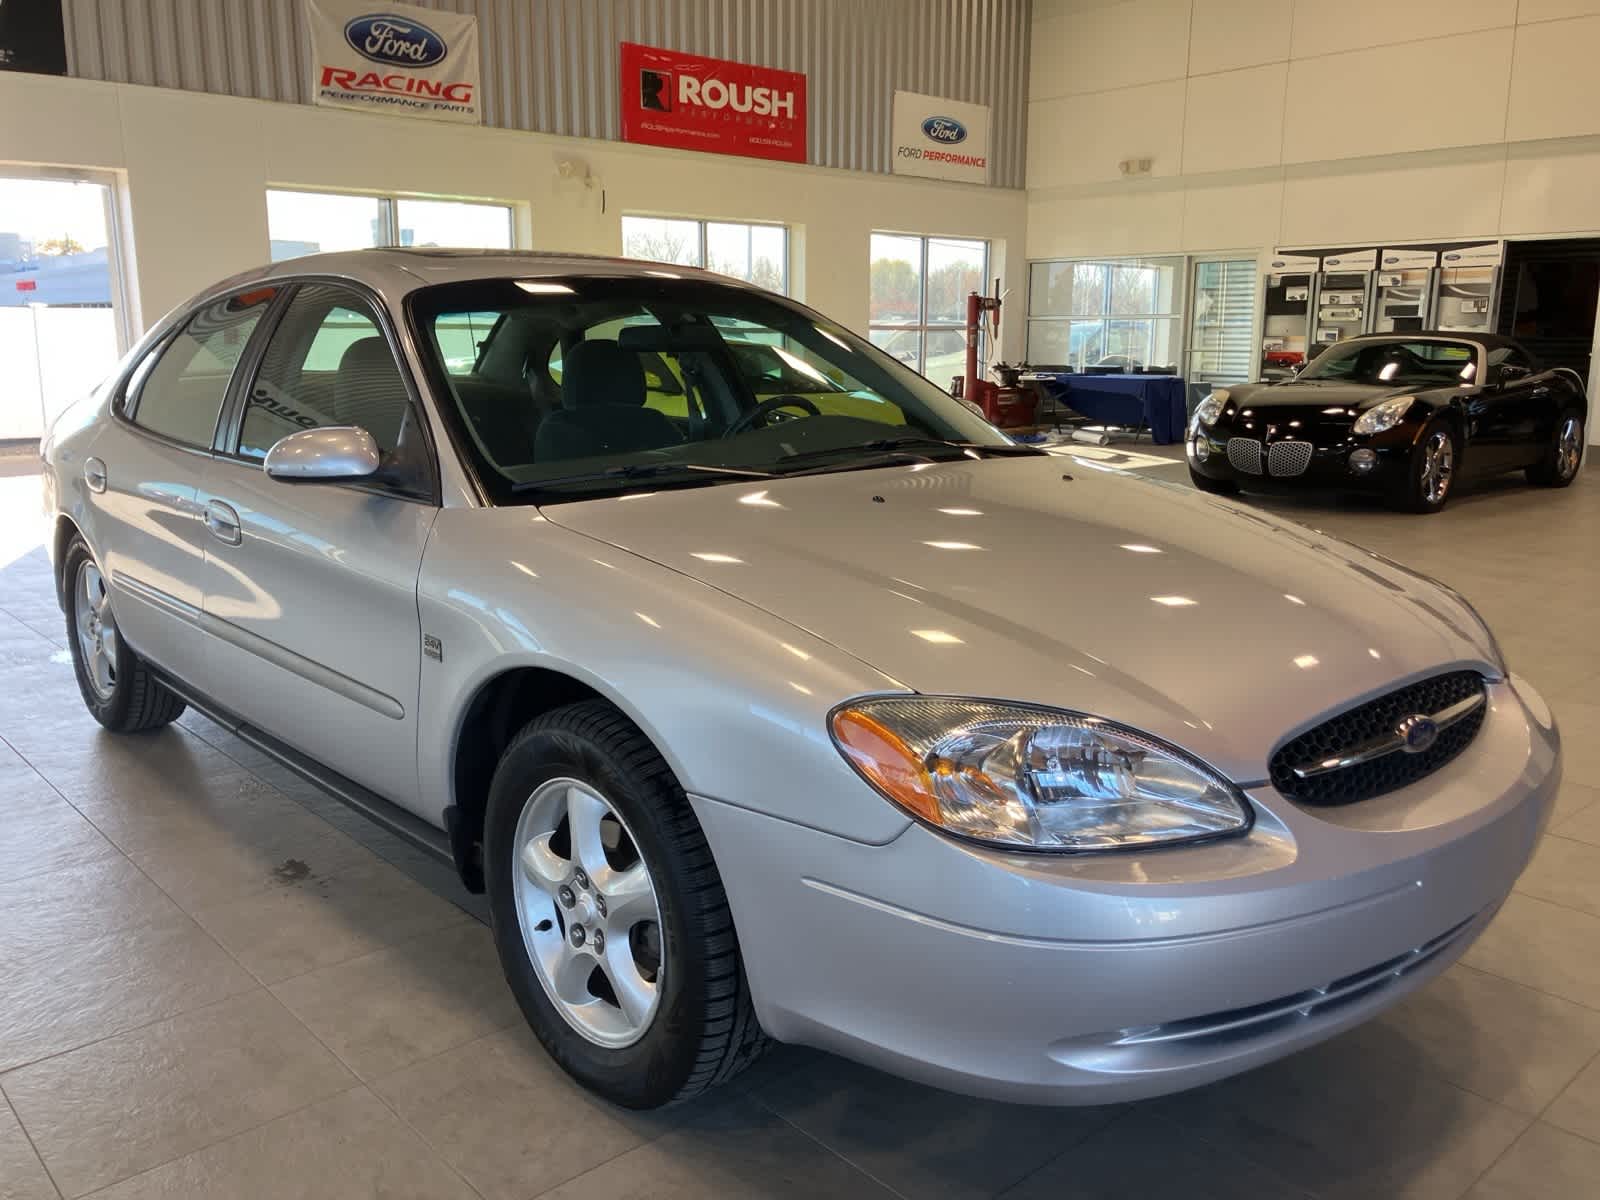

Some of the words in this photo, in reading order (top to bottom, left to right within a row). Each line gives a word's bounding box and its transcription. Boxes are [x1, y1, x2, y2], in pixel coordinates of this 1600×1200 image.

[365, 21, 428, 61] Ford
[321, 66, 474, 103] RACING
[678, 75, 794, 119] ROUSH
[320, 90, 431, 109] PERFORMANCE
[434, 103, 474, 113] PARTS
[930, 119, 959, 140] Ford
[898, 146, 921, 160] FORD
[923, 150, 987, 168] PERFORMANCE
